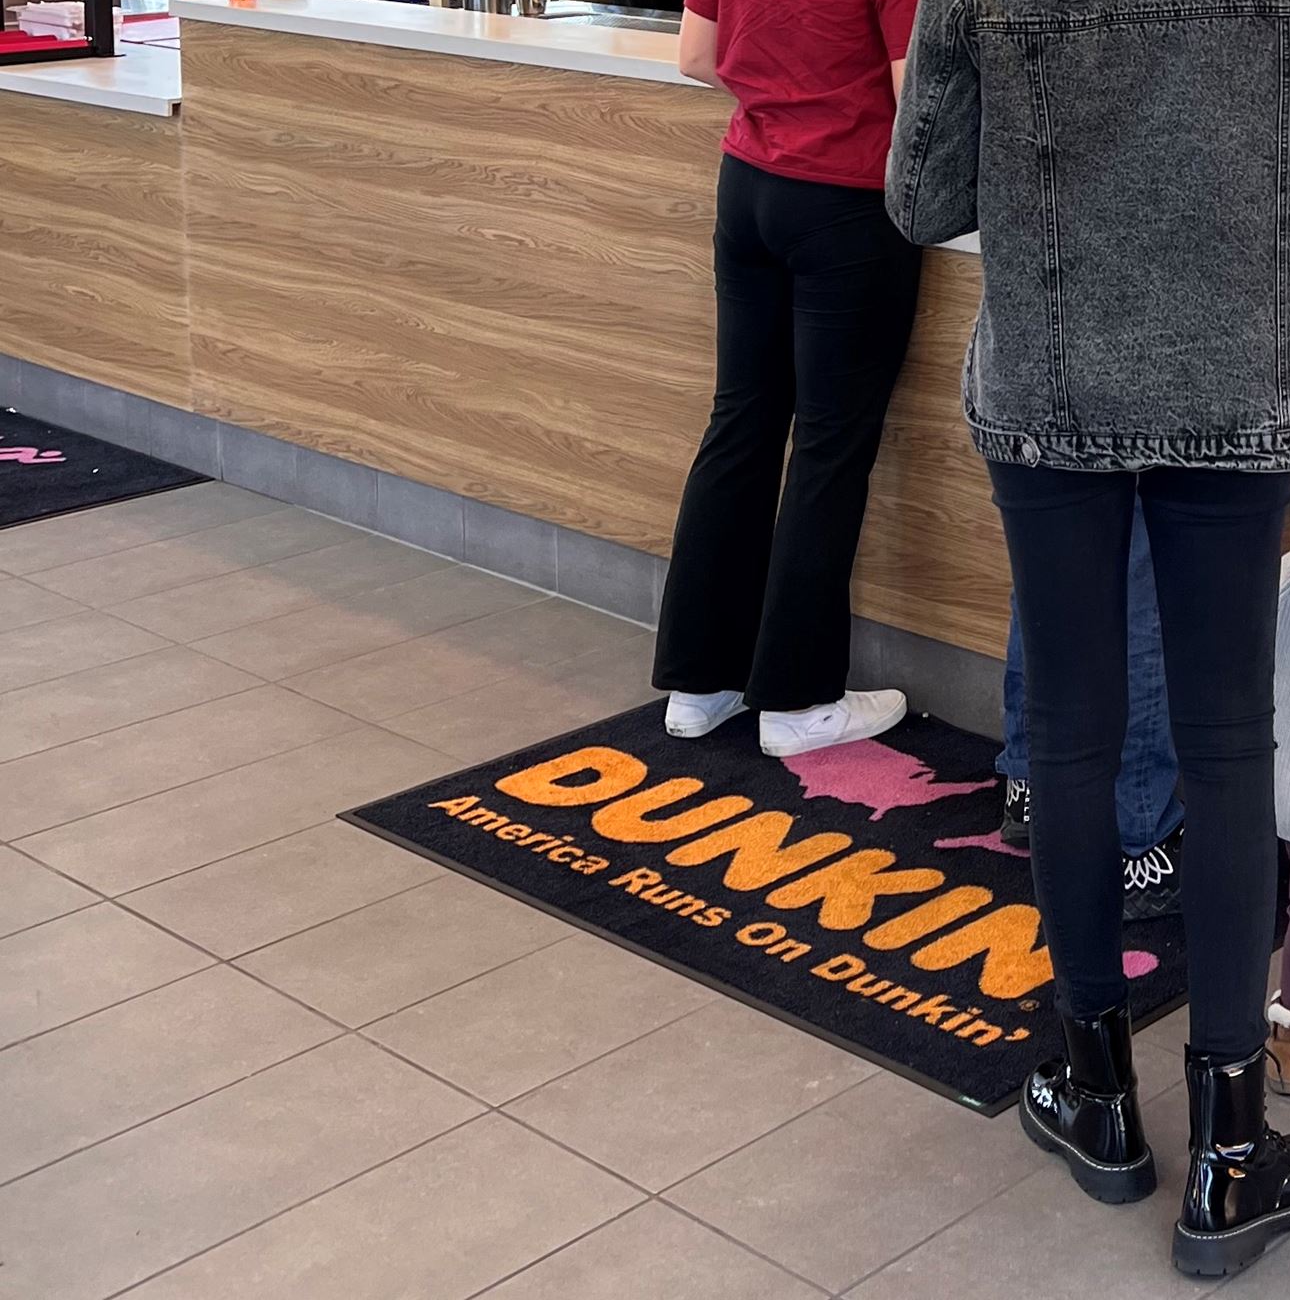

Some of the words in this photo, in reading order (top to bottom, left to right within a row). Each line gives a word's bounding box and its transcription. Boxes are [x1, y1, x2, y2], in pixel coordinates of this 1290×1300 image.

[427, 796, 610, 876] America
[609, 867, 732, 928] Runs
[735, 922, 812, 963] On
[810, 953, 1032, 1048] Dunkin'
[495, 746, 1054, 1000] DUNKIN
